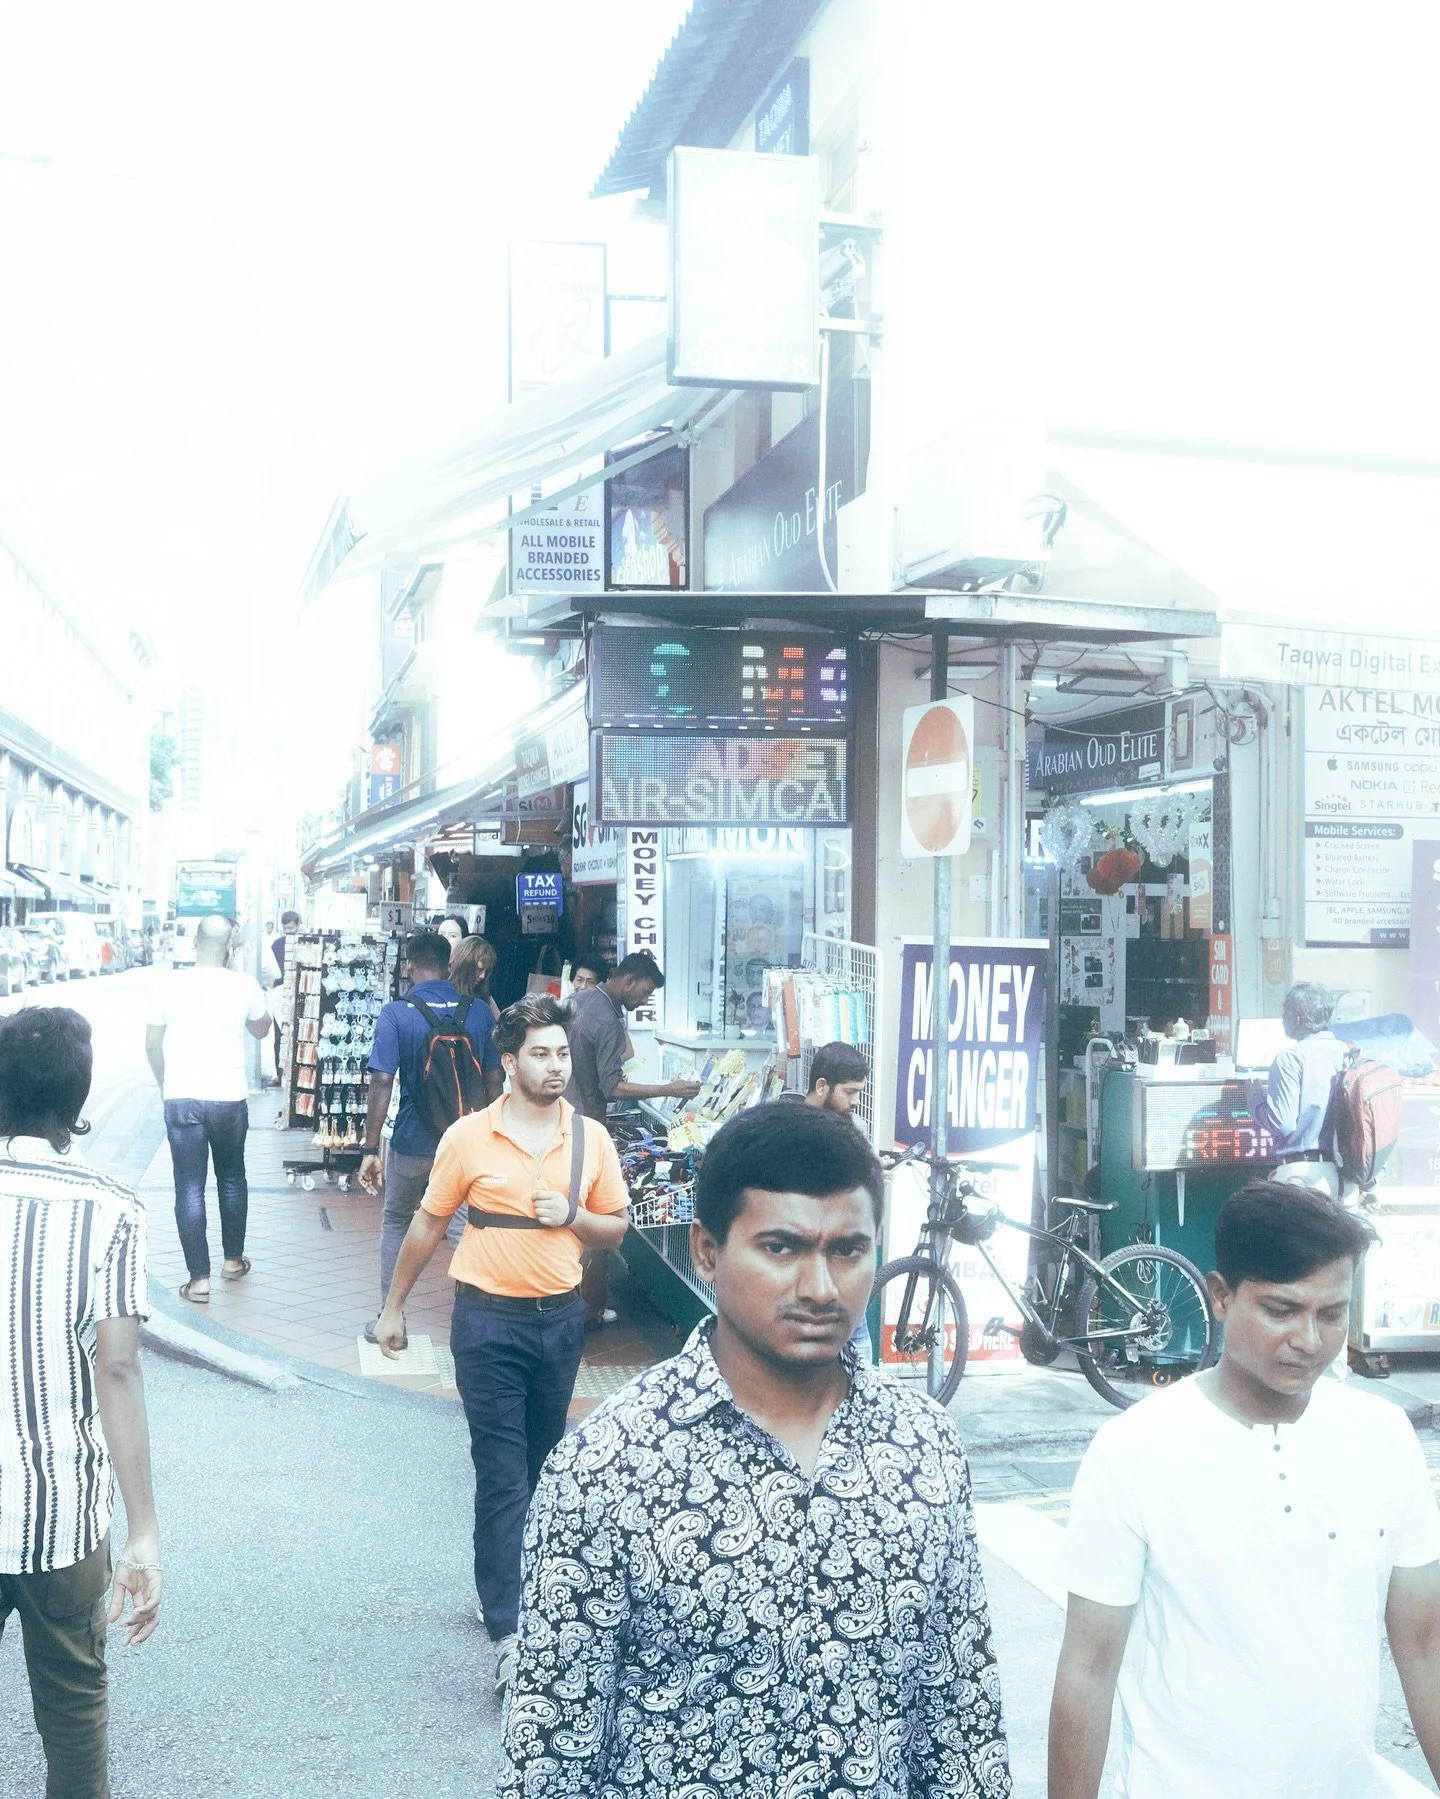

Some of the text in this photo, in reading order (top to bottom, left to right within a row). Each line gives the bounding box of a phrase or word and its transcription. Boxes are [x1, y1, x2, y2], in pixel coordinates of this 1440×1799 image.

[565, 518, 573, 527] &
[574, 519, 601, 528] RETAIL
[521, 535, 597, 549] ALL MOBILE
[528, 551, 590, 565] BRANDED
[516, 567, 601, 581] ACCESSORIES
[1277, 642, 1343, 670] Taqwa
[1350, 648, 1414, 675] Digital
[1317, 689, 1404, 714] AKTEL
[1034, 730, 1158, 778] ARABIAN OUD ELITE
[1347, 760, 1400, 772] SAMSUNG
[1350, 780, 1398, 790] NOKIA
[1314, 800, 1352, 813] Singtel
[1359, 799, 1423, 810] STARHUB
[1314, 825, 1396, 837] Mobile Services:
[1325, 841, 1353, 850] Cracked
[632, 832, 658, 906] MONEY
[1325, 865, 1350, 875] Charge
[525, 874, 556, 888] TAX
[524, 888, 558, 898] REFUND
[1325, 890, 1357, 899] Software
[1344, 916, 1375, 925] branded
[1214, 940, 1226, 961] SIM
[1211, 963, 1229, 985] CARD
[911, 960, 1036, 1044] MONEY
